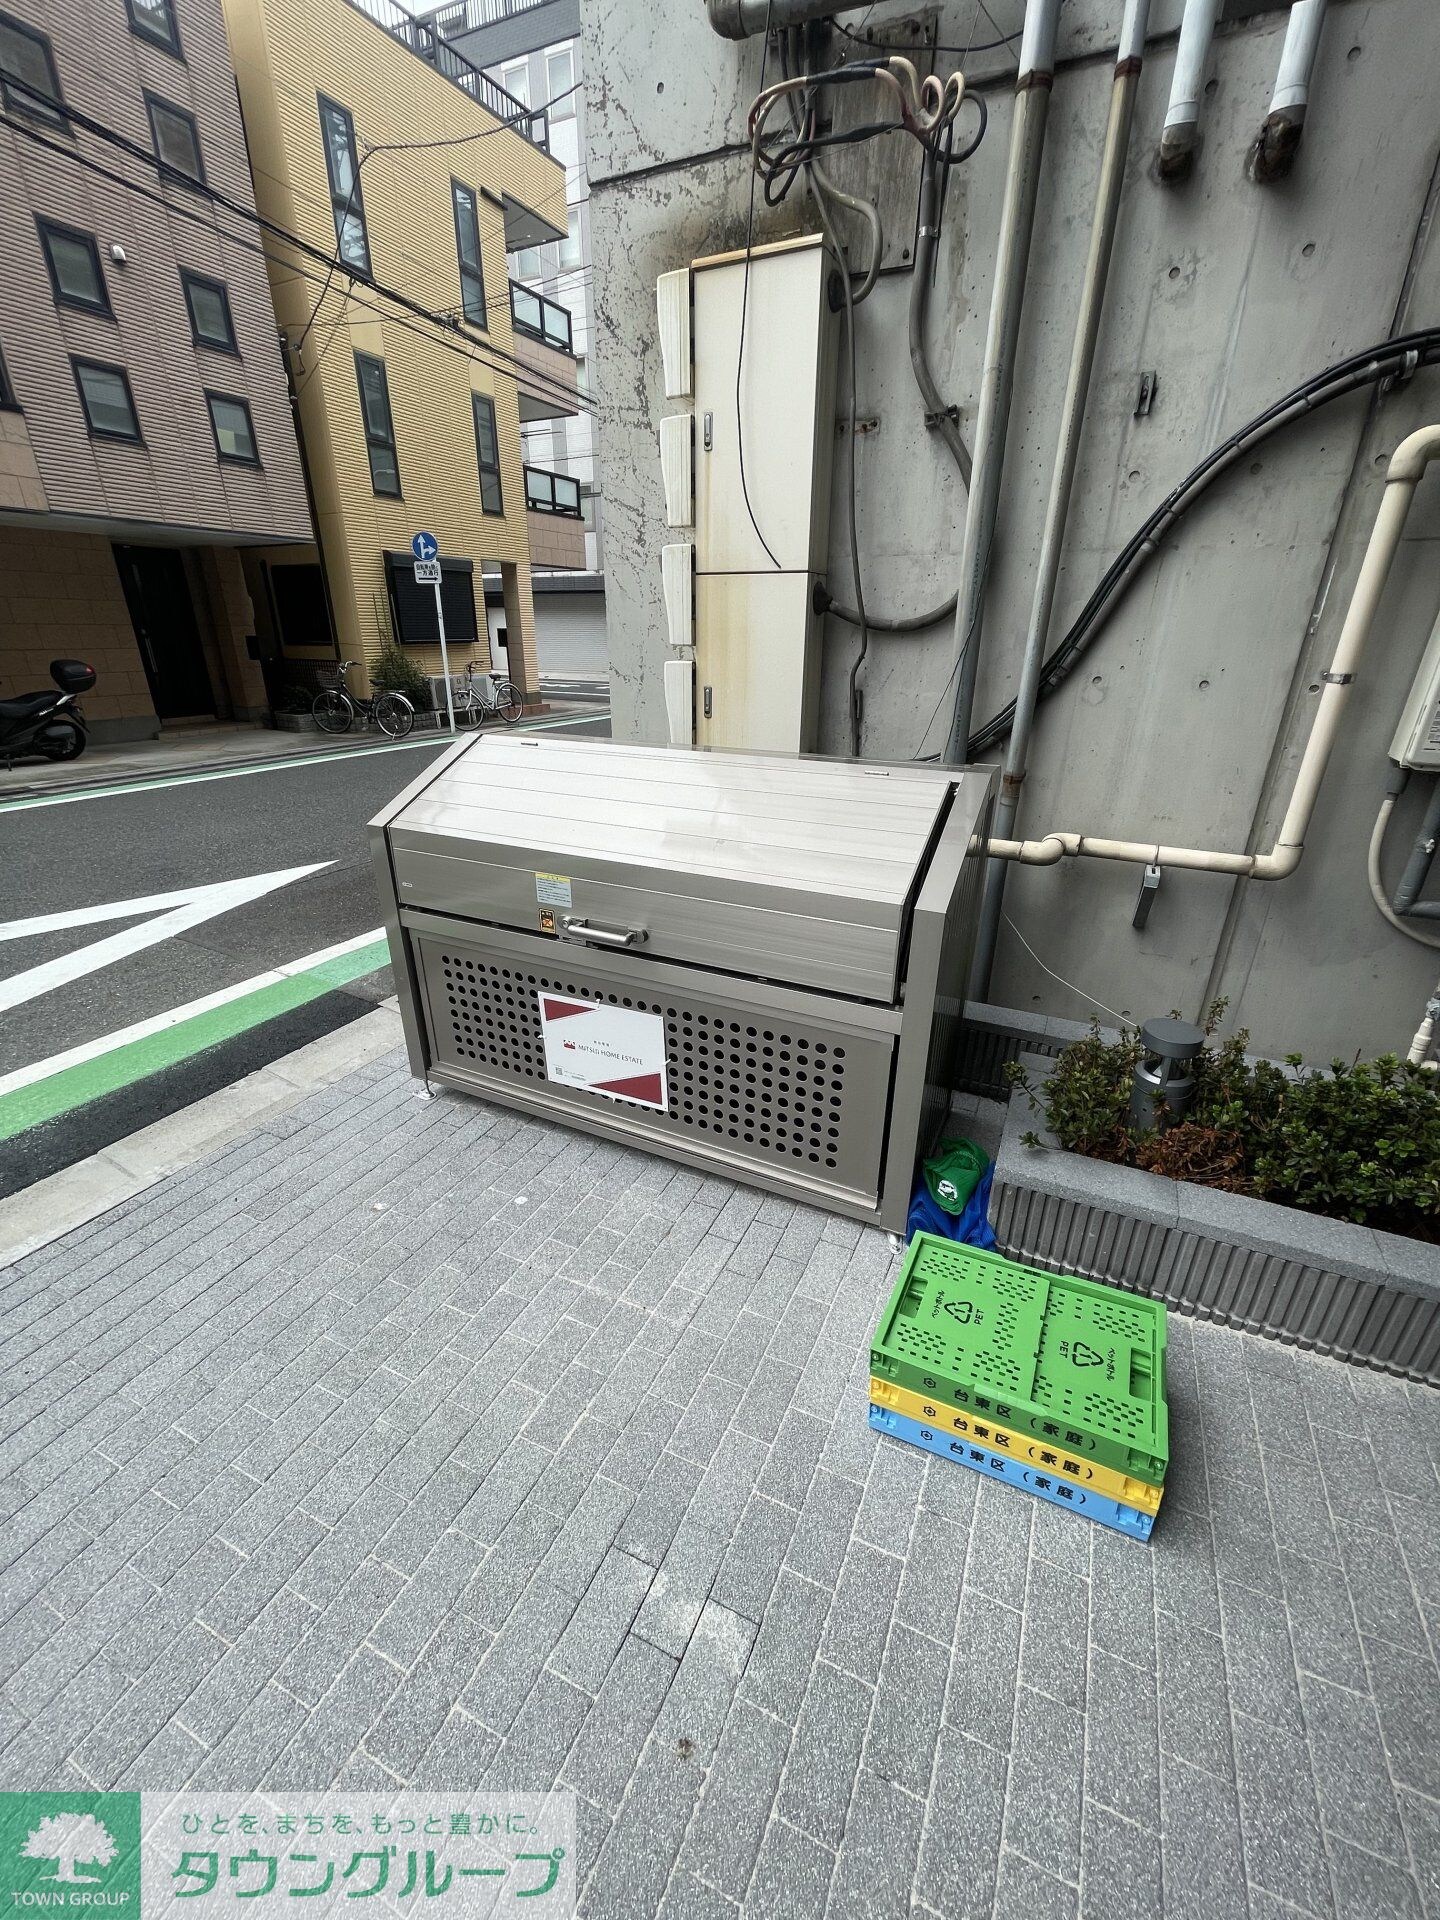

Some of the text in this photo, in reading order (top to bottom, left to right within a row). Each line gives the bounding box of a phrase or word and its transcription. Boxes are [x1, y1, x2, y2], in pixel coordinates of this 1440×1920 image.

[578, 1044, 643, 1065] MITSUI HOME ESTATE
[974, 1309, 984, 1325] PET
[1059, 1341, 1069, 1358] PET
